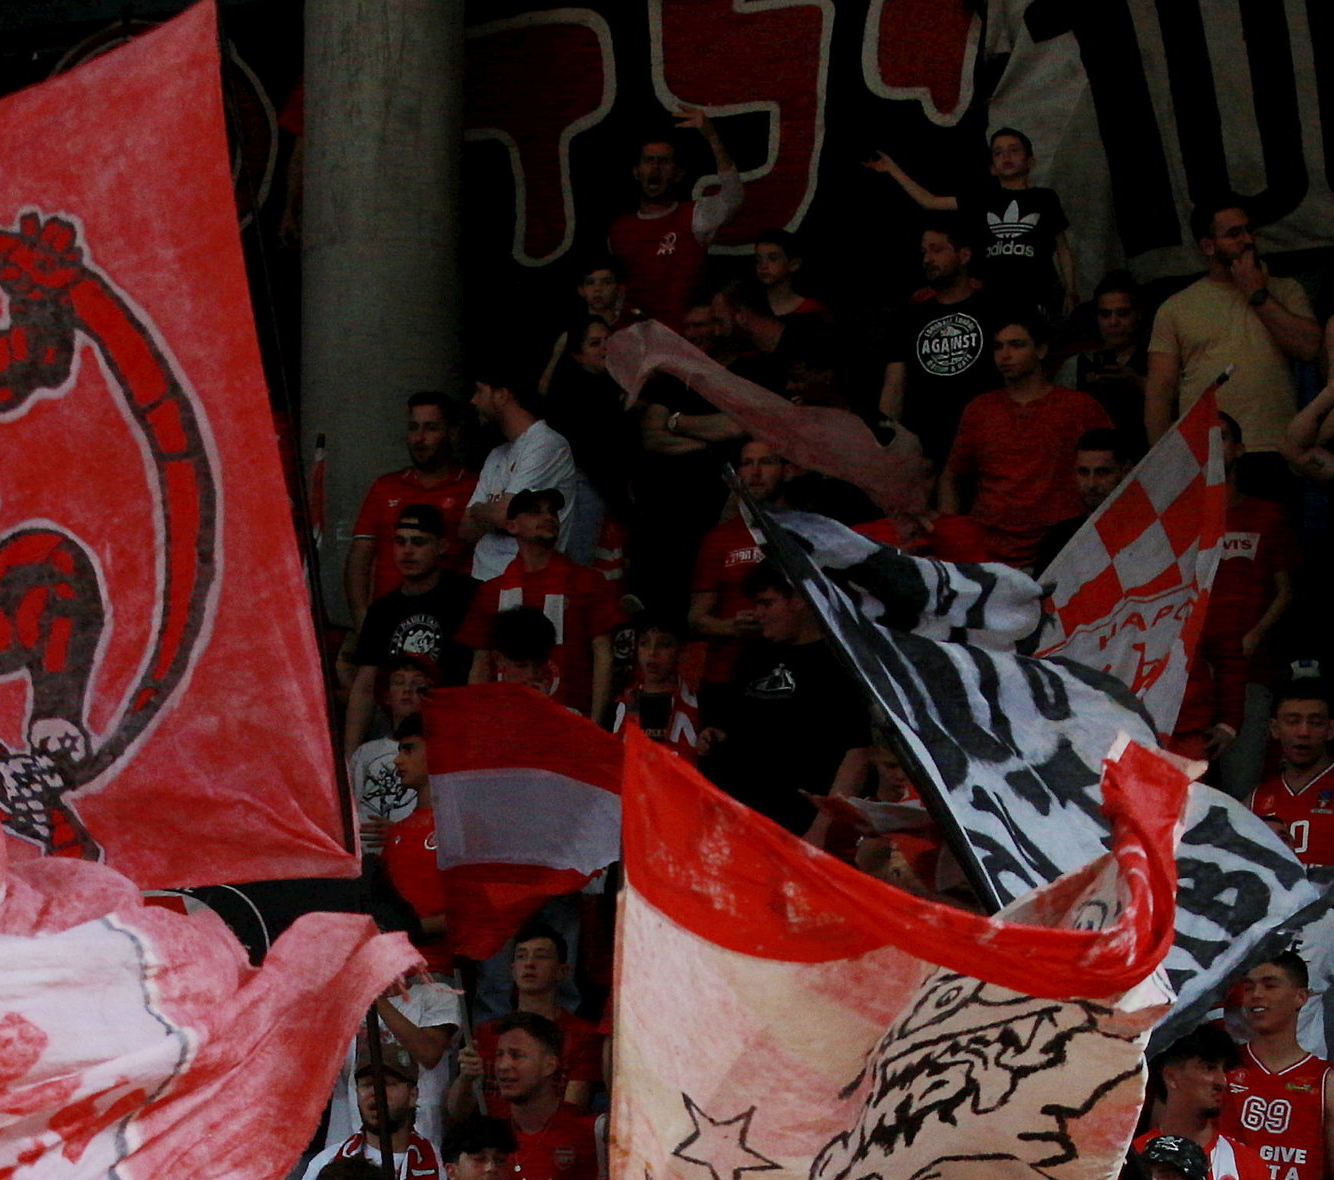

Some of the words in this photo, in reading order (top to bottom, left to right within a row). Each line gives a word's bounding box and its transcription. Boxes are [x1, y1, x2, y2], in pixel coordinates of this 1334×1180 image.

[921, 332, 979, 355] AGAINST
[1239, 1094, 1293, 1135] 69
[1258, 1145, 1308, 1167] GIVE
